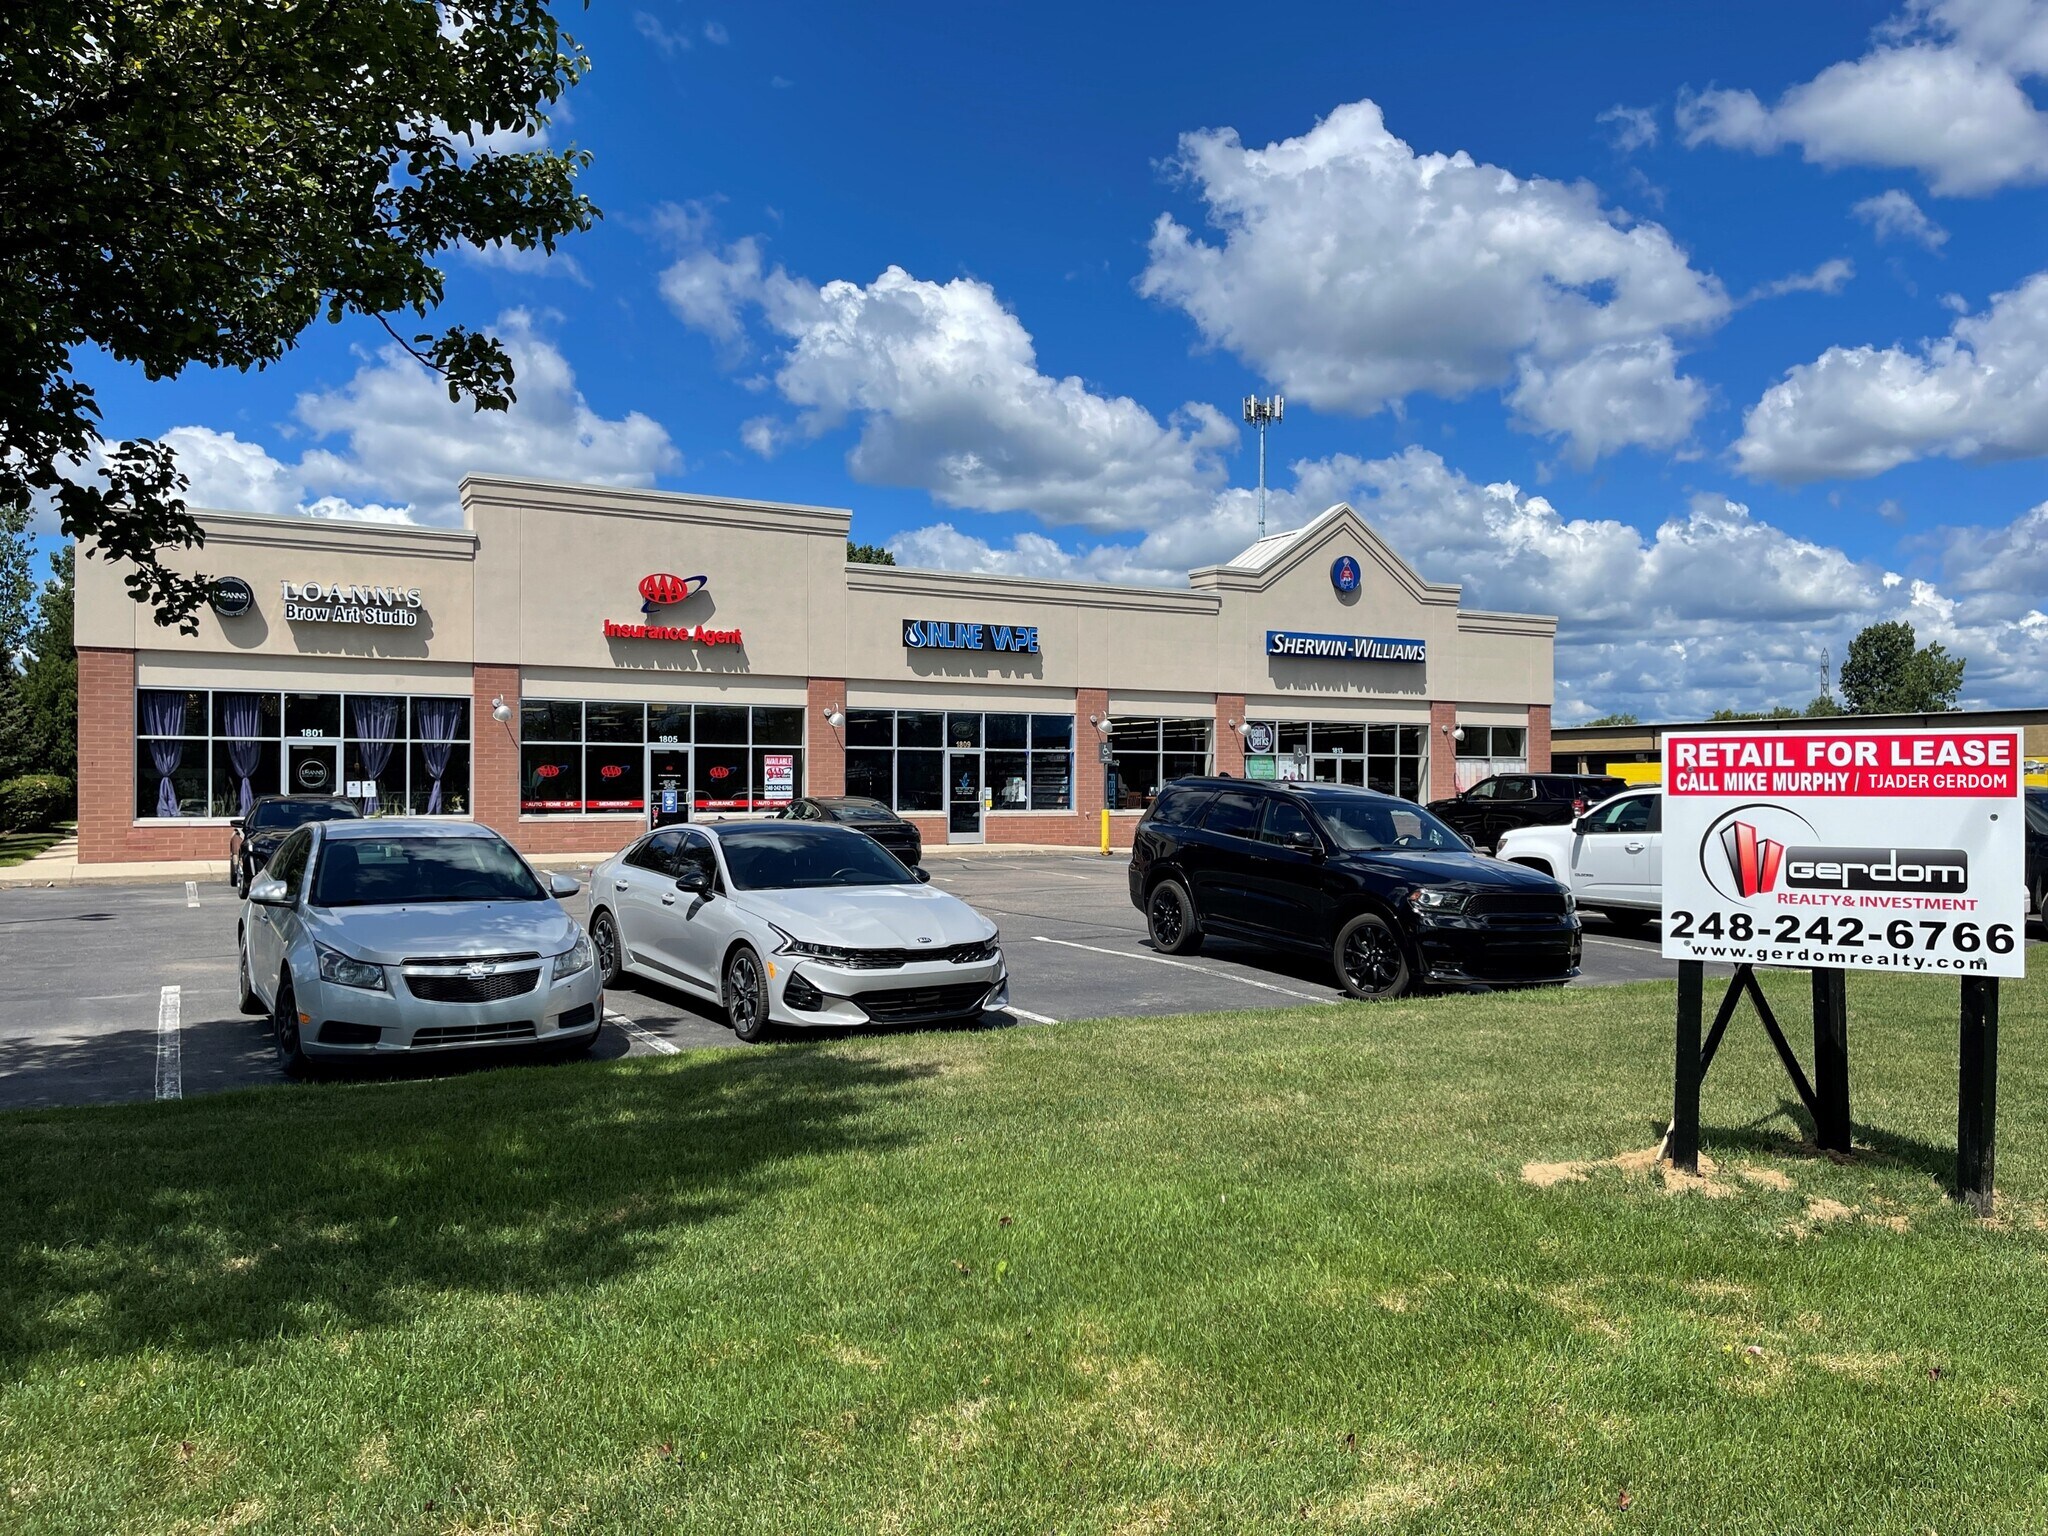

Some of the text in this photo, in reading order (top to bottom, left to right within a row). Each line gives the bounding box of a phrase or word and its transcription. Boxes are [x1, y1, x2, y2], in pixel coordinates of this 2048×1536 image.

[281, 580, 422, 608] LOANN'S
[641, 574, 687, 603] AAA
[286, 603, 417, 625] Brow Art Studio
[603, 619, 742, 647] Insurance Agent
[927, 621, 1039, 652] INLINE VAPE
[301, 729, 323, 737] 1801
[659, 735, 678, 743] 1805
[1252, 737, 1268, 747] perks
[766, 757, 792, 765] AVAILABLE
[1676, 740, 2010, 767] RETAIL FOR LEASE
[601, 765, 621, 777] AAA
[710, 767, 729, 778] AAA
[1676, 773, 1719, 791] CALL
[1724, 773, 1767, 791] MIKE
[1772, 772, 1849, 791] MURPHY
[1868, 774, 1929, 789] TJADER
[1933, 774, 2007, 788] GERDOM
[1859, 896, 1978, 911] INVESTMENT
[1670, 910, 2014, 954] 248-242-6766
[1691, 945, 1988, 970] www.gerdomrealty.com
